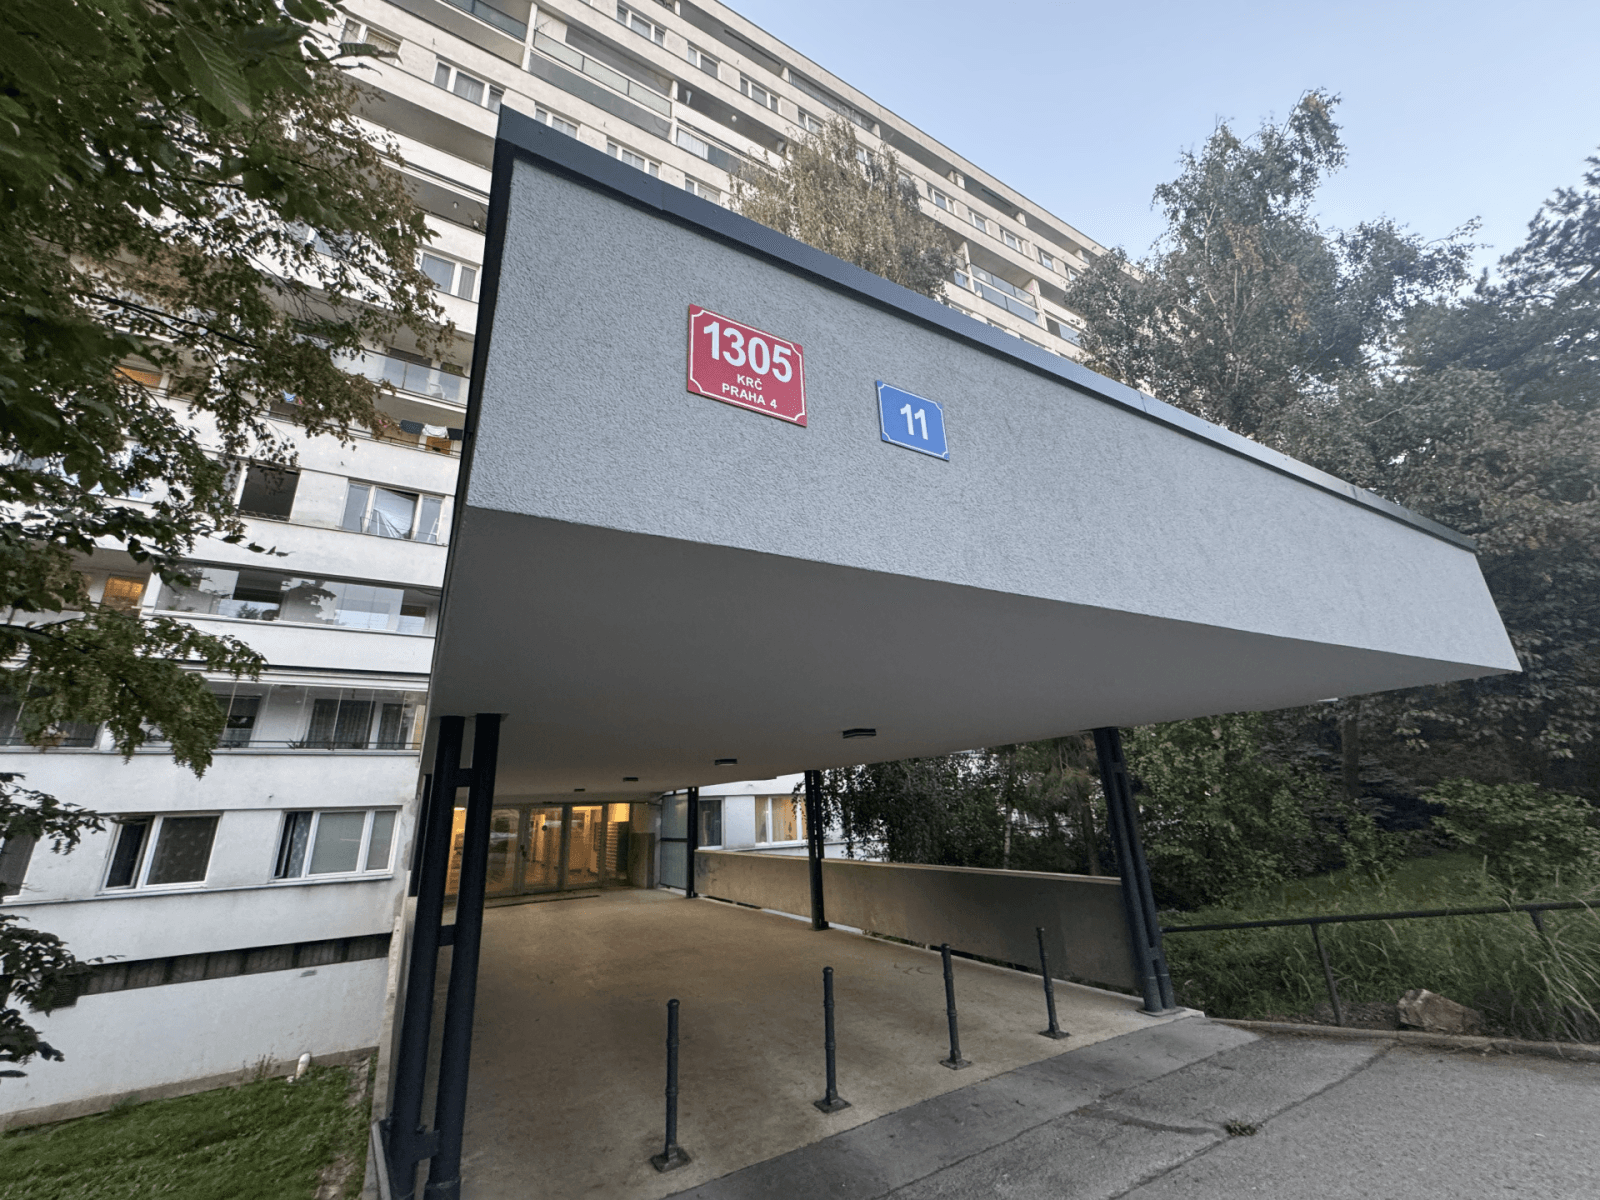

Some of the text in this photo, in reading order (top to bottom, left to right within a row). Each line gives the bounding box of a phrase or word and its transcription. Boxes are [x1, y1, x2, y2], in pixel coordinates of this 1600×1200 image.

[703, 320, 793, 383] 1305
[721, 382, 778, 410] PRAHA 4
[736, 373, 763, 391] KRČ
[899, 403, 929, 441] 11
